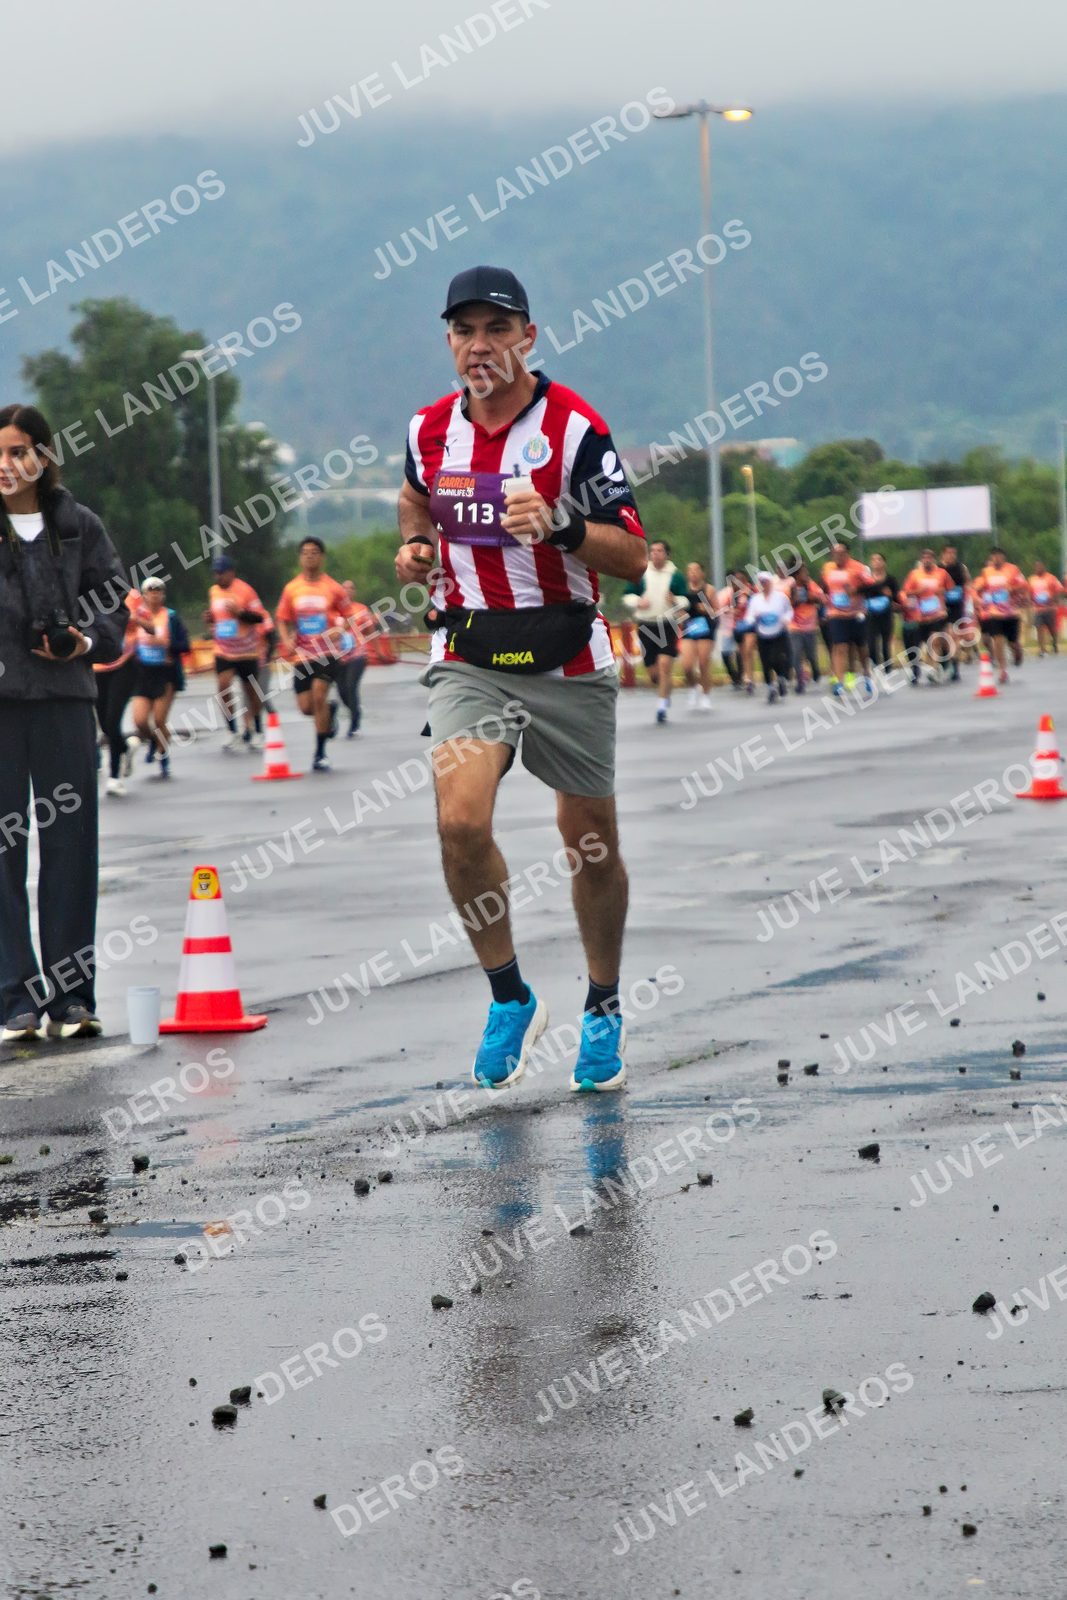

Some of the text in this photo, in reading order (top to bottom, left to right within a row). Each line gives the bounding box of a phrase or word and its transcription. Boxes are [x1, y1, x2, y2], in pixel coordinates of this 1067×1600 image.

[438, 476, 476, 488] CARRERA
[453, 501, 494, 524] 113
[492, 650, 534, 665] HOKA
